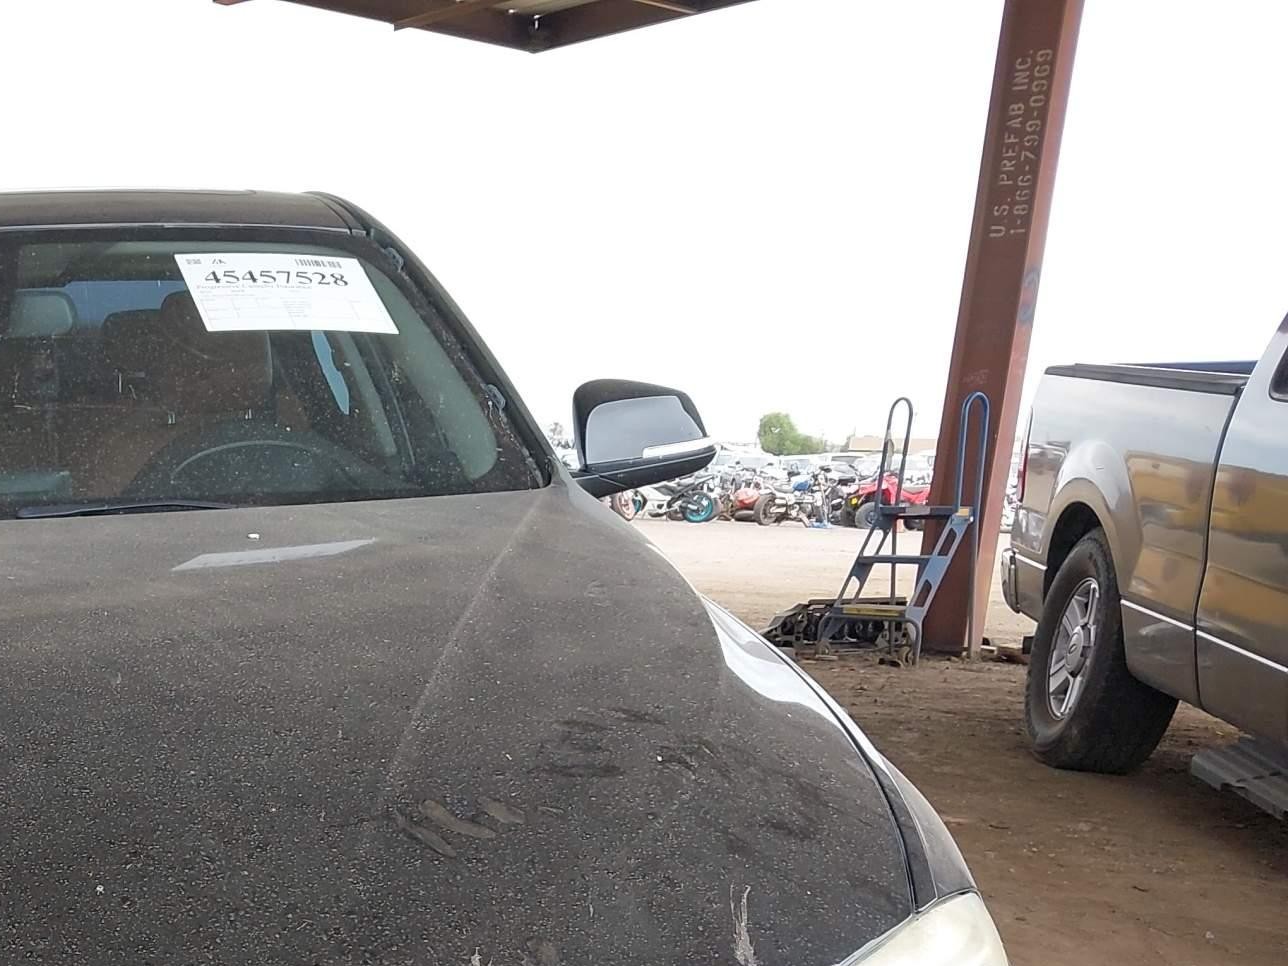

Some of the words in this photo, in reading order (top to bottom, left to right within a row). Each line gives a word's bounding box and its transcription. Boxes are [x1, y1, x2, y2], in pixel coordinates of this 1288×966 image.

[1012, 49, 1034, 91] INC.
[999, 102, 1025, 185] PREFAB
[1010, 48, 1053, 235] 1-866-799-0969
[989, 198, 1011, 238] U.S.
[204, 270, 349, 287] 45457528
